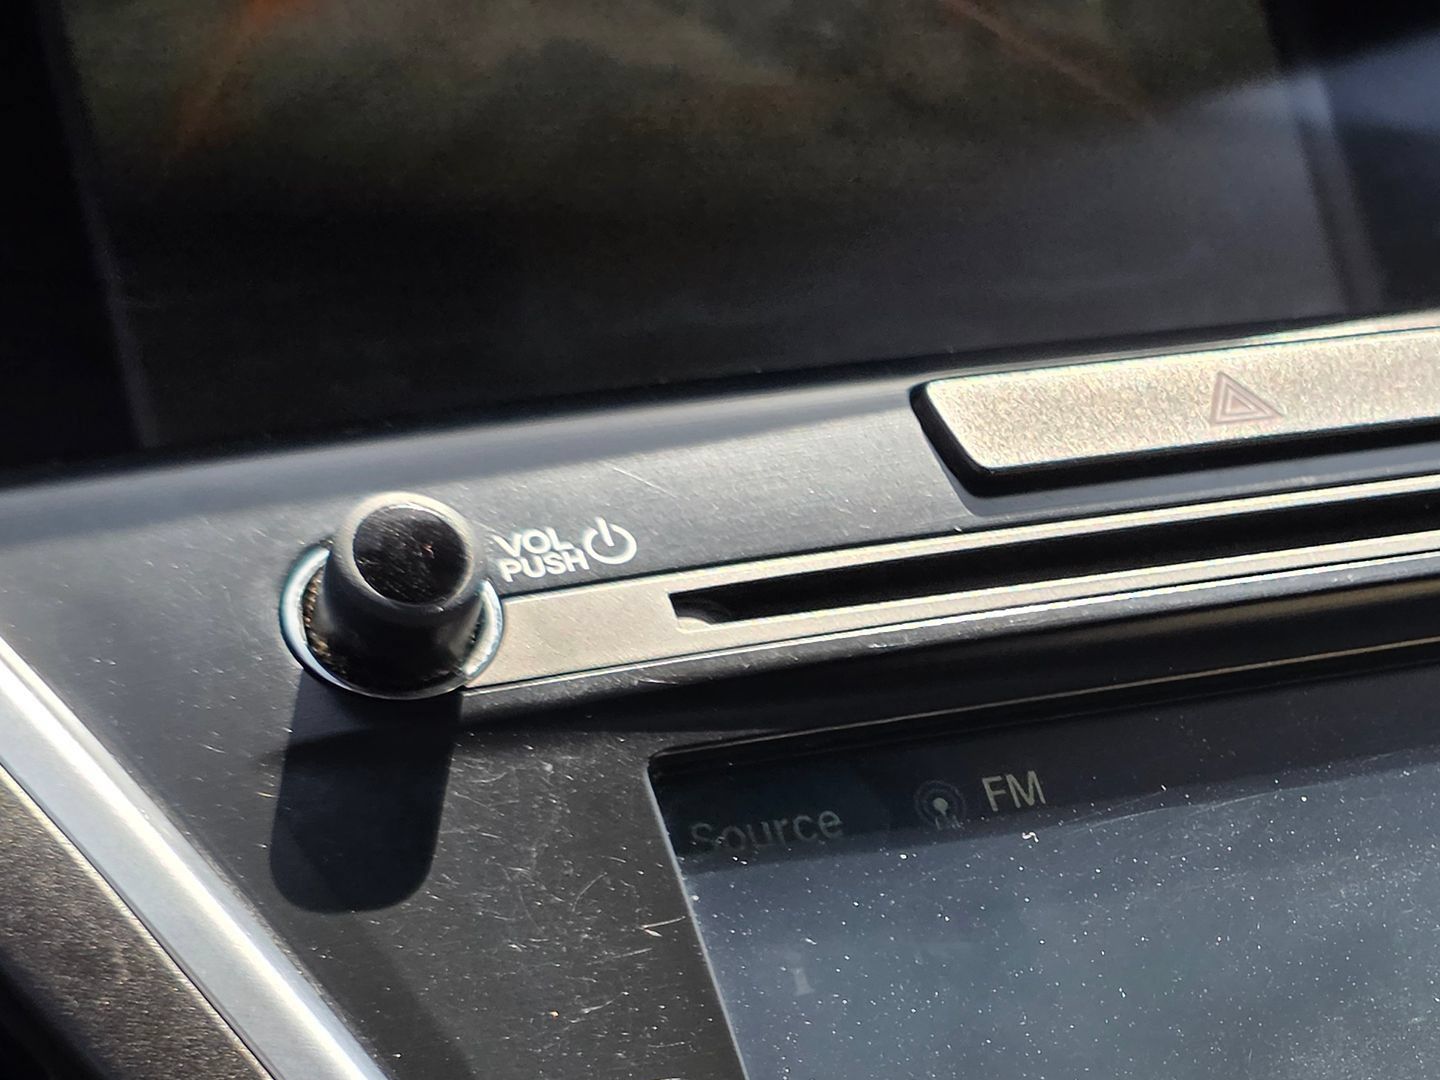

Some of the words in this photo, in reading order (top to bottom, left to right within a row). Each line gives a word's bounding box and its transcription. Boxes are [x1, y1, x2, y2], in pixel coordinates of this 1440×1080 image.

[491, 526, 574, 558] VOL
[498, 547, 590, 583] PUSH
[981, 770, 1046, 812] FM
[689, 808, 844, 854] Source
